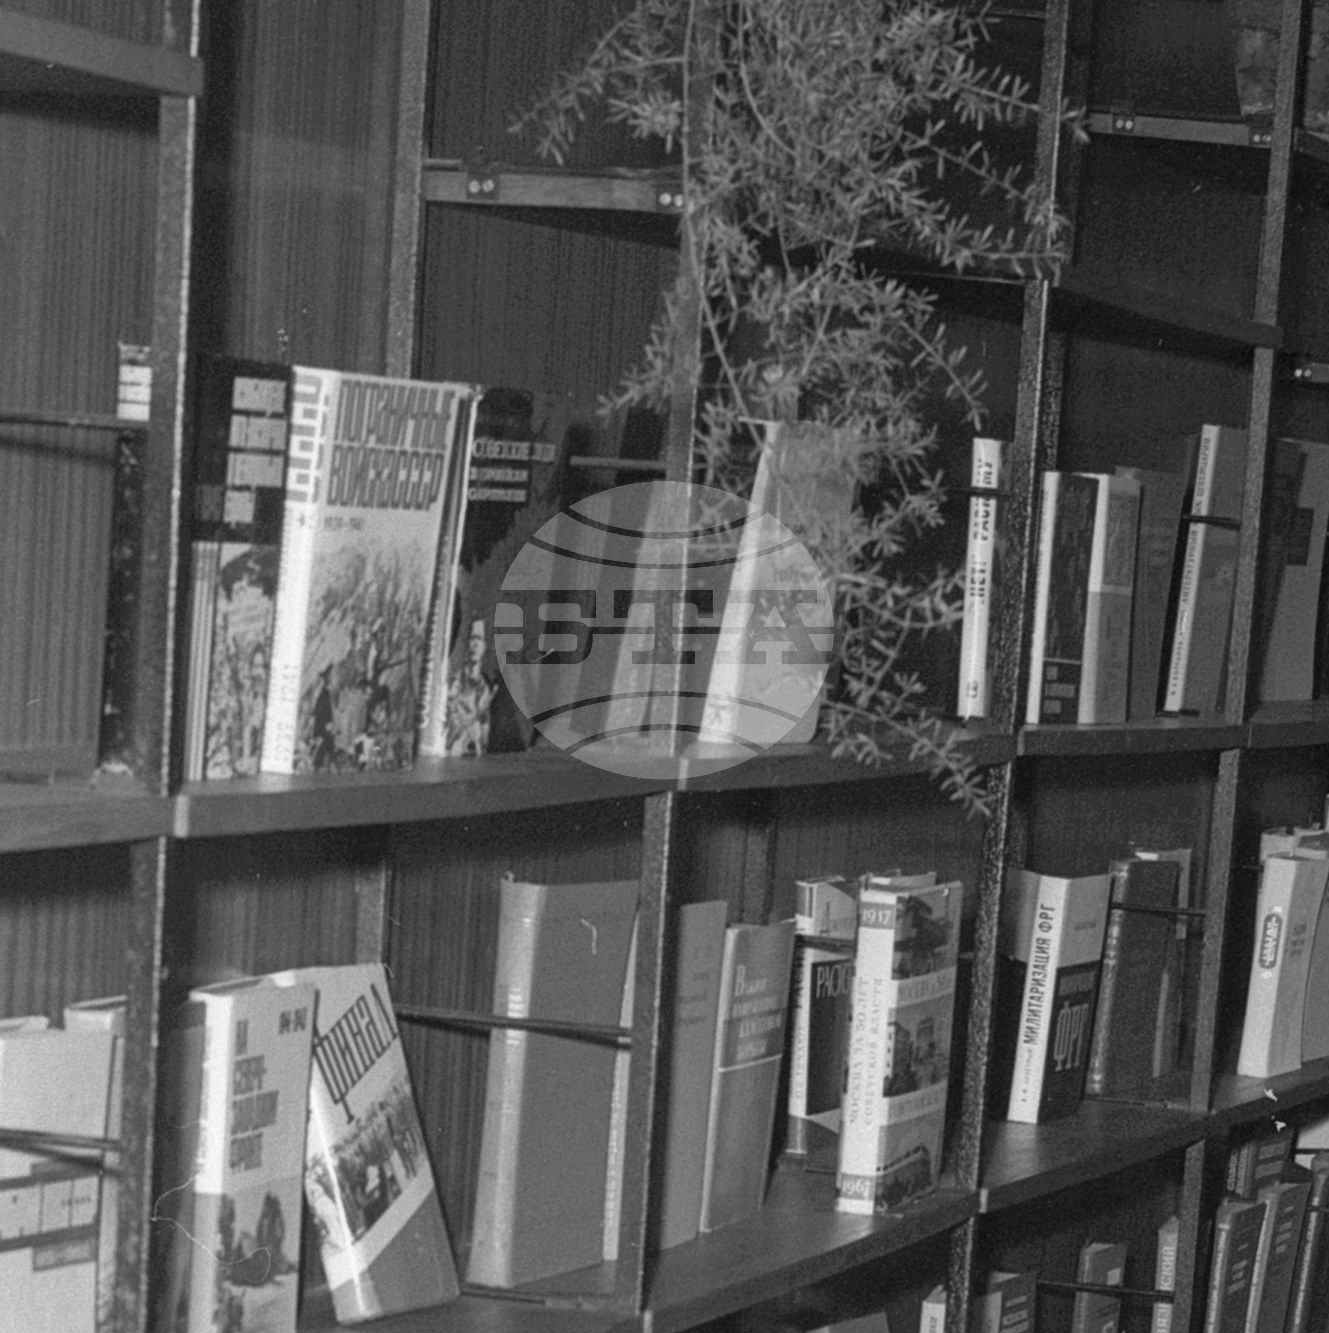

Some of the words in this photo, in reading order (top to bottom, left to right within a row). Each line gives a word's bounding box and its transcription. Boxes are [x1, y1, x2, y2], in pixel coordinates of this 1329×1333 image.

[862, 905, 894, 926] 1917
[1022, 937, 1051, 1046] МИЛИТАРИЗАЦИЯ
[1039, 903, 1056, 934] ФРГ
